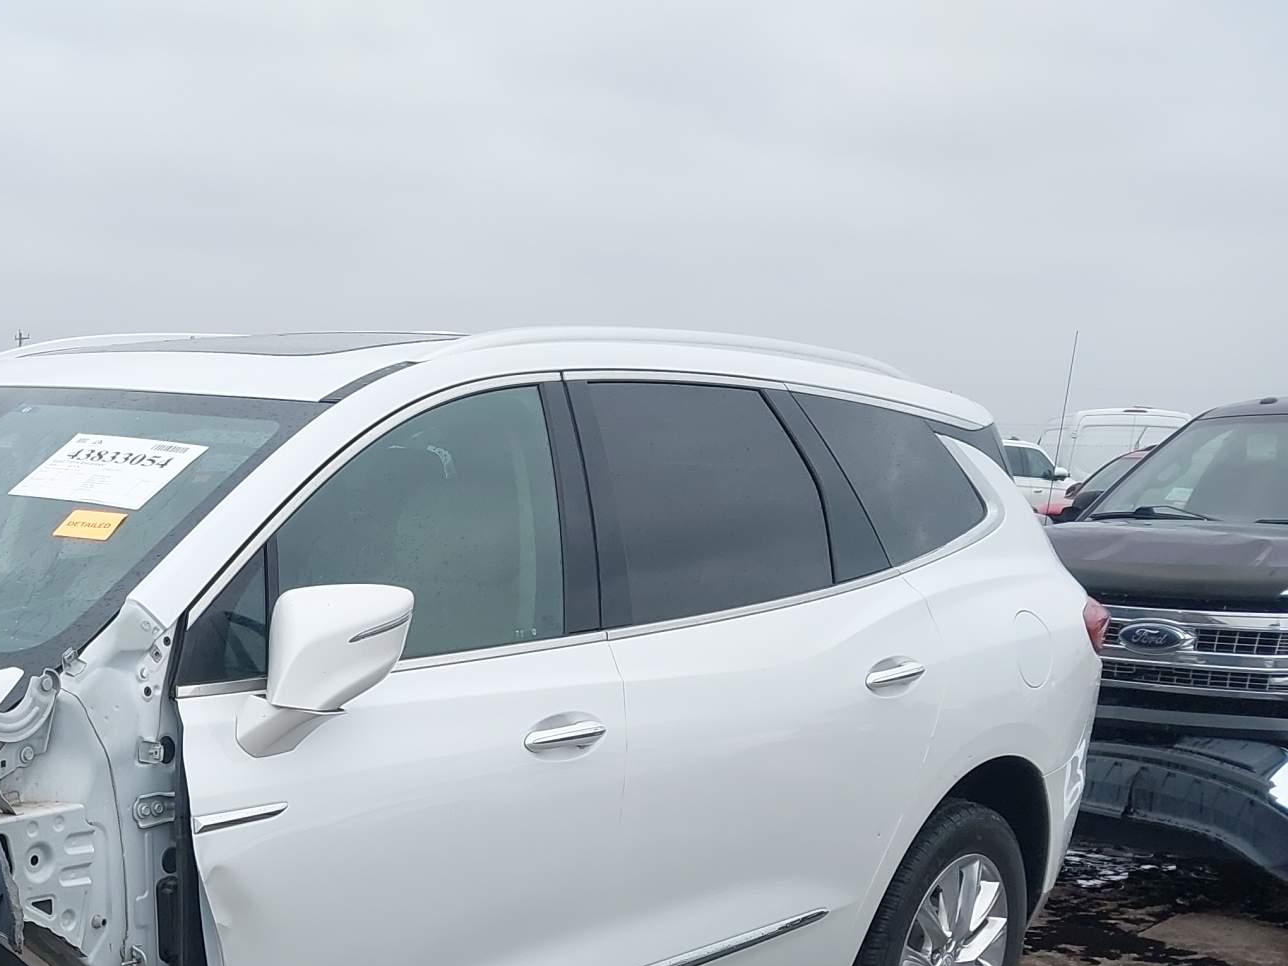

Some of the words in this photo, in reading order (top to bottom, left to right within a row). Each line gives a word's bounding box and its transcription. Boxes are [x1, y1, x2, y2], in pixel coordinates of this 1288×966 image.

[66, 448, 174, 469] 43833054
[66, 521, 112, 529] DETAILED
[1131, 628, 1168, 645] Ford
